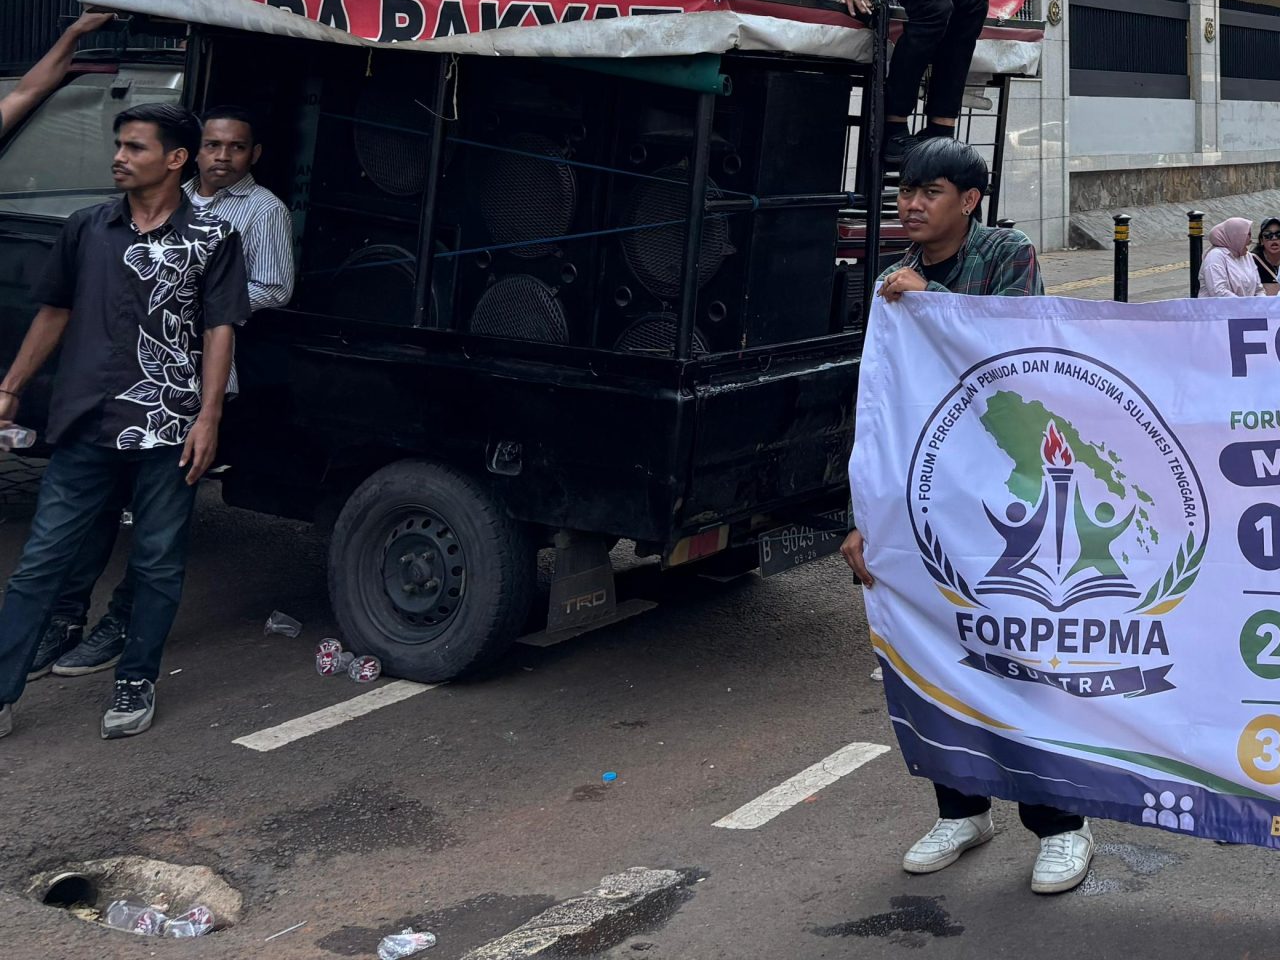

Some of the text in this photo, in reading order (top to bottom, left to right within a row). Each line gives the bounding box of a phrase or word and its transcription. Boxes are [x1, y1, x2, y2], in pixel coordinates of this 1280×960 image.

[919, 451, 938, 501] FORUM
[977, 362, 1019, 389] PEMUDA
[1022, 360, 1049, 374] DAN
[1054, 361, 1125, 404] MAHASISWA
[1123, 399, 1174, 456] SULAWESI
[1168, 456, 1197, 519] TENGGARA
[762, 536, 771, 562] B
[1254, 515, 1274, 557] 1
[561, 589, 606, 614] TRD
[955, 612, 1169, 656] FORPEPMA
